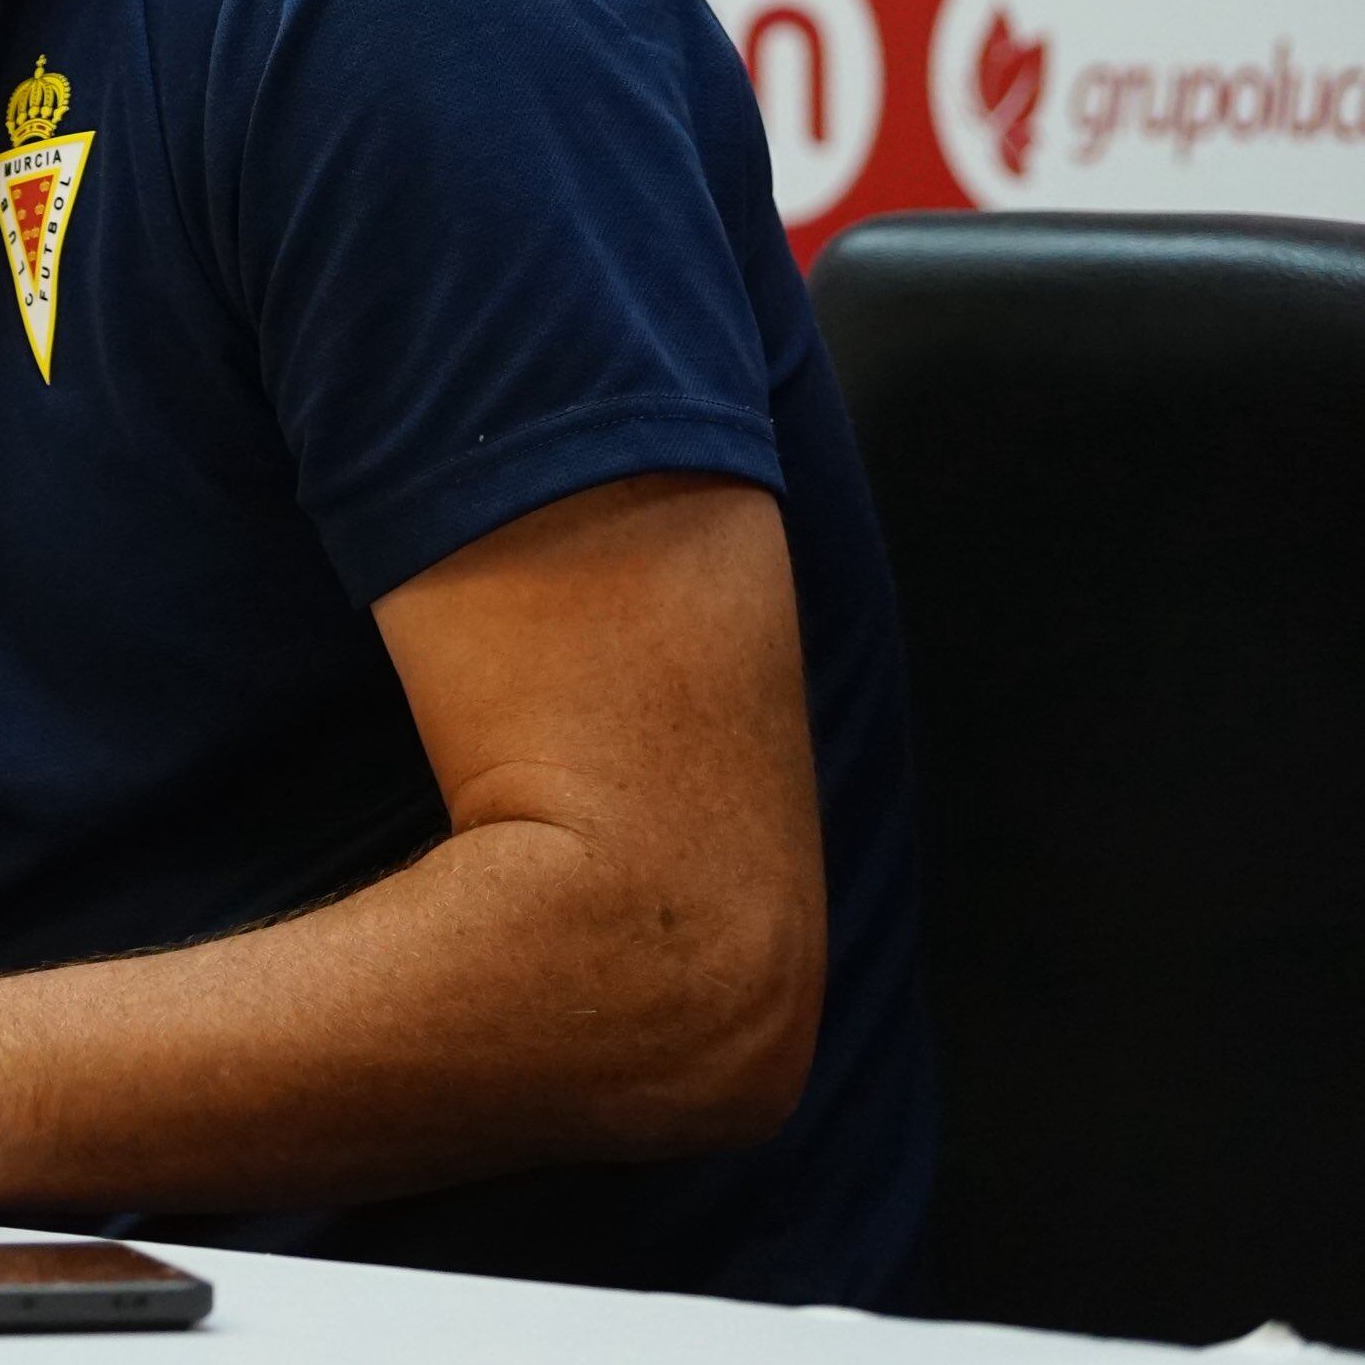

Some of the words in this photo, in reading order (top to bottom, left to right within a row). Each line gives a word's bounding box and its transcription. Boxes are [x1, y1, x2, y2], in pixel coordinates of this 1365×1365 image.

[3, 149, 63, 178] MURCIA
[0, 196, 35, 307] CLUB
[39, 175, 73, 302] FUTBOL
